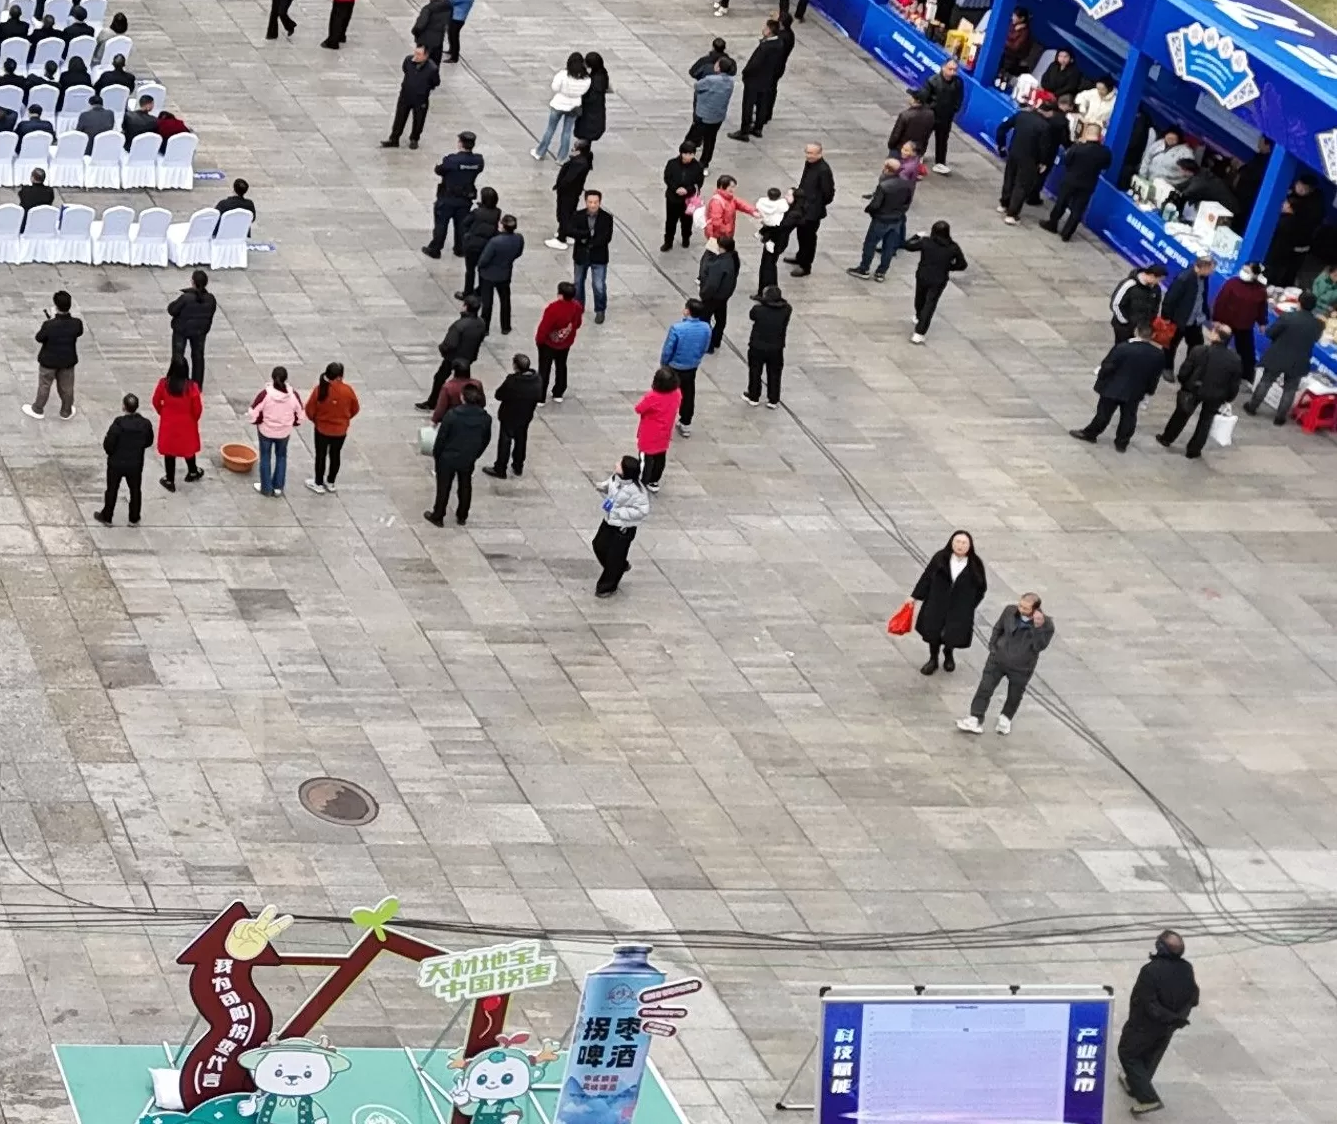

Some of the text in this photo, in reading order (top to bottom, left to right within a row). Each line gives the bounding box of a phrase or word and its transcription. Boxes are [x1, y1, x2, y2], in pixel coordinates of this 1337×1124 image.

[424, 945, 536, 983] 天材地宝
[440, 962, 552, 999] 中国拐枣
[582, 1016, 642, 1042] 拐枣
[576, 1044, 639, 1069] 啤酒
[830, 1027, 855, 1094] 科技赋能
[1073, 1027, 1099, 1093] 产业兴市
